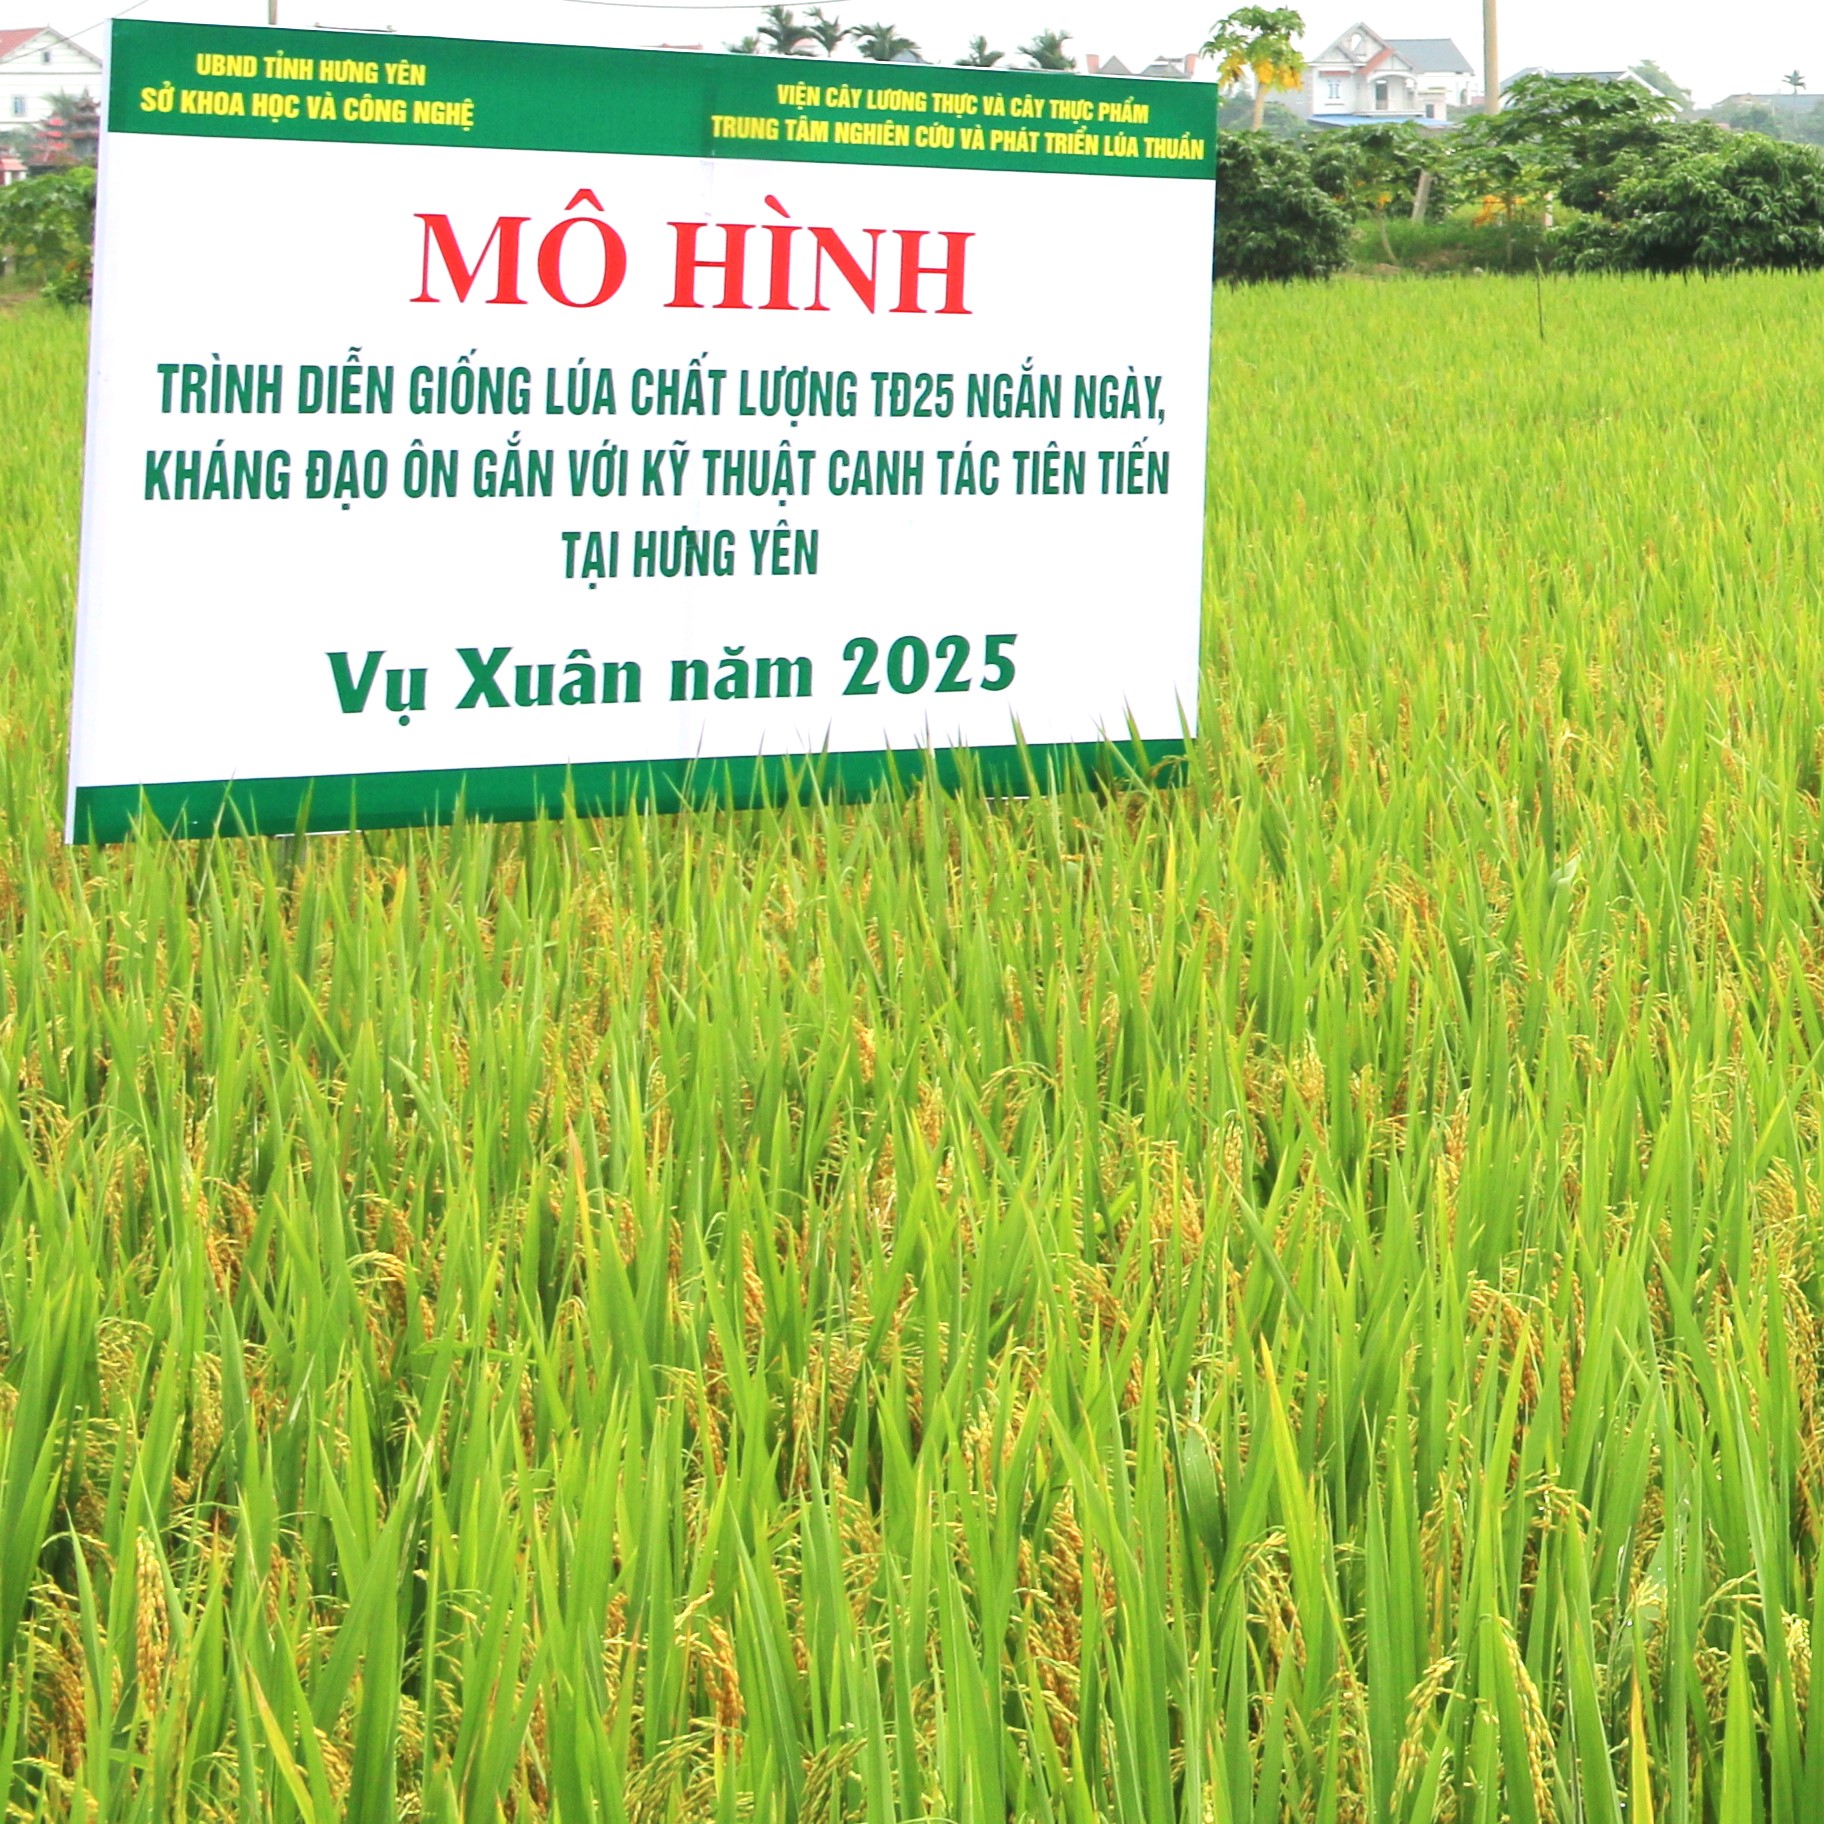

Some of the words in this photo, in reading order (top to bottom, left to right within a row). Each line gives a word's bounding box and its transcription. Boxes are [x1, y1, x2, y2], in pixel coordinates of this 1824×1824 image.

[195, 52, 258, 78] UBND
[262, 49, 314, 81] TỈNH
[318, 58, 379, 84] HƯNG
[384, 59, 427, 86] YÊN
[776, 80, 821, 111] VIỆN
[824, 83, 863, 109] CÂY
[865, 88, 928, 113] LƯƠNG
[931, 92, 979, 119] THỰC
[982, 92, 1006, 117] VÀ
[1009, 93, 1046, 119] CÂY
[1048, 98, 1095, 125] THỰC
[1097, 95, 1150, 124] PHẨM
[139, 80, 176, 113] SỞ
[179, 89, 246, 117] KHOA
[250, 92, 301, 123] HỌC
[305, 91, 337, 121] VÀ
[342, 93, 408, 124] CÔNG
[412, 97, 475, 132] NGHỆ
[710, 114, 780, 141] TRUNG
[784, 114, 830, 143] TÂM
[833, 119, 911, 147] NGHIÊN
[914, 121, 956, 149] CỨU
[959, 124, 986, 151] VÀ
[989, 126, 1041, 153] PHÁT
[1043, 125, 1100, 156] TRIỂN
[1102, 131, 1140, 158] LÚA
[409, 188, 627, 309] MÔ
[663, 194, 976, 315] HÌNH
[156, 352, 283, 414] TRÌNH
[297, 346, 394, 415] DIỄN
[409, 348, 531, 416] GIỐNG
[545, 357, 617, 416] LÚA
[631, 351, 727, 416] CHẤT
[739, 365, 858, 428] LƯỢNG
[870, 371, 954, 419] TĐ25
[966, 356, 1062, 419] NGẮN
[1073, 365, 1165, 425] NGÀY,
[144, 438, 291, 501] KHÁNG
[305, 449, 388, 511] ĐẠO
[403, 438, 459, 499] ÔN
[473, 430, 554, 498] GẮN
[568, 438, 629, 498] VỚI
[642, 439, 690, 497] KỸ
[702, 439, 816, 507] THUẬT
[828, 449, 924, 497] CANH
[936, 440, 1000, 496] TÁC
[1012, 440, 1086, 495] TIÊN
[1097, 436, 1170, 495] TIẾN
[561, 531, 619, 590] TẠI
[633, 525, 735, 578] HƯNG
[749, 518, 819, 576] YÊN
[325, 650, 428, 727] Vụ
[455, 646, 641, 710] Xuân
[669, 645, 813, 702] năm
[842, 633, 1018, 696] 2025
